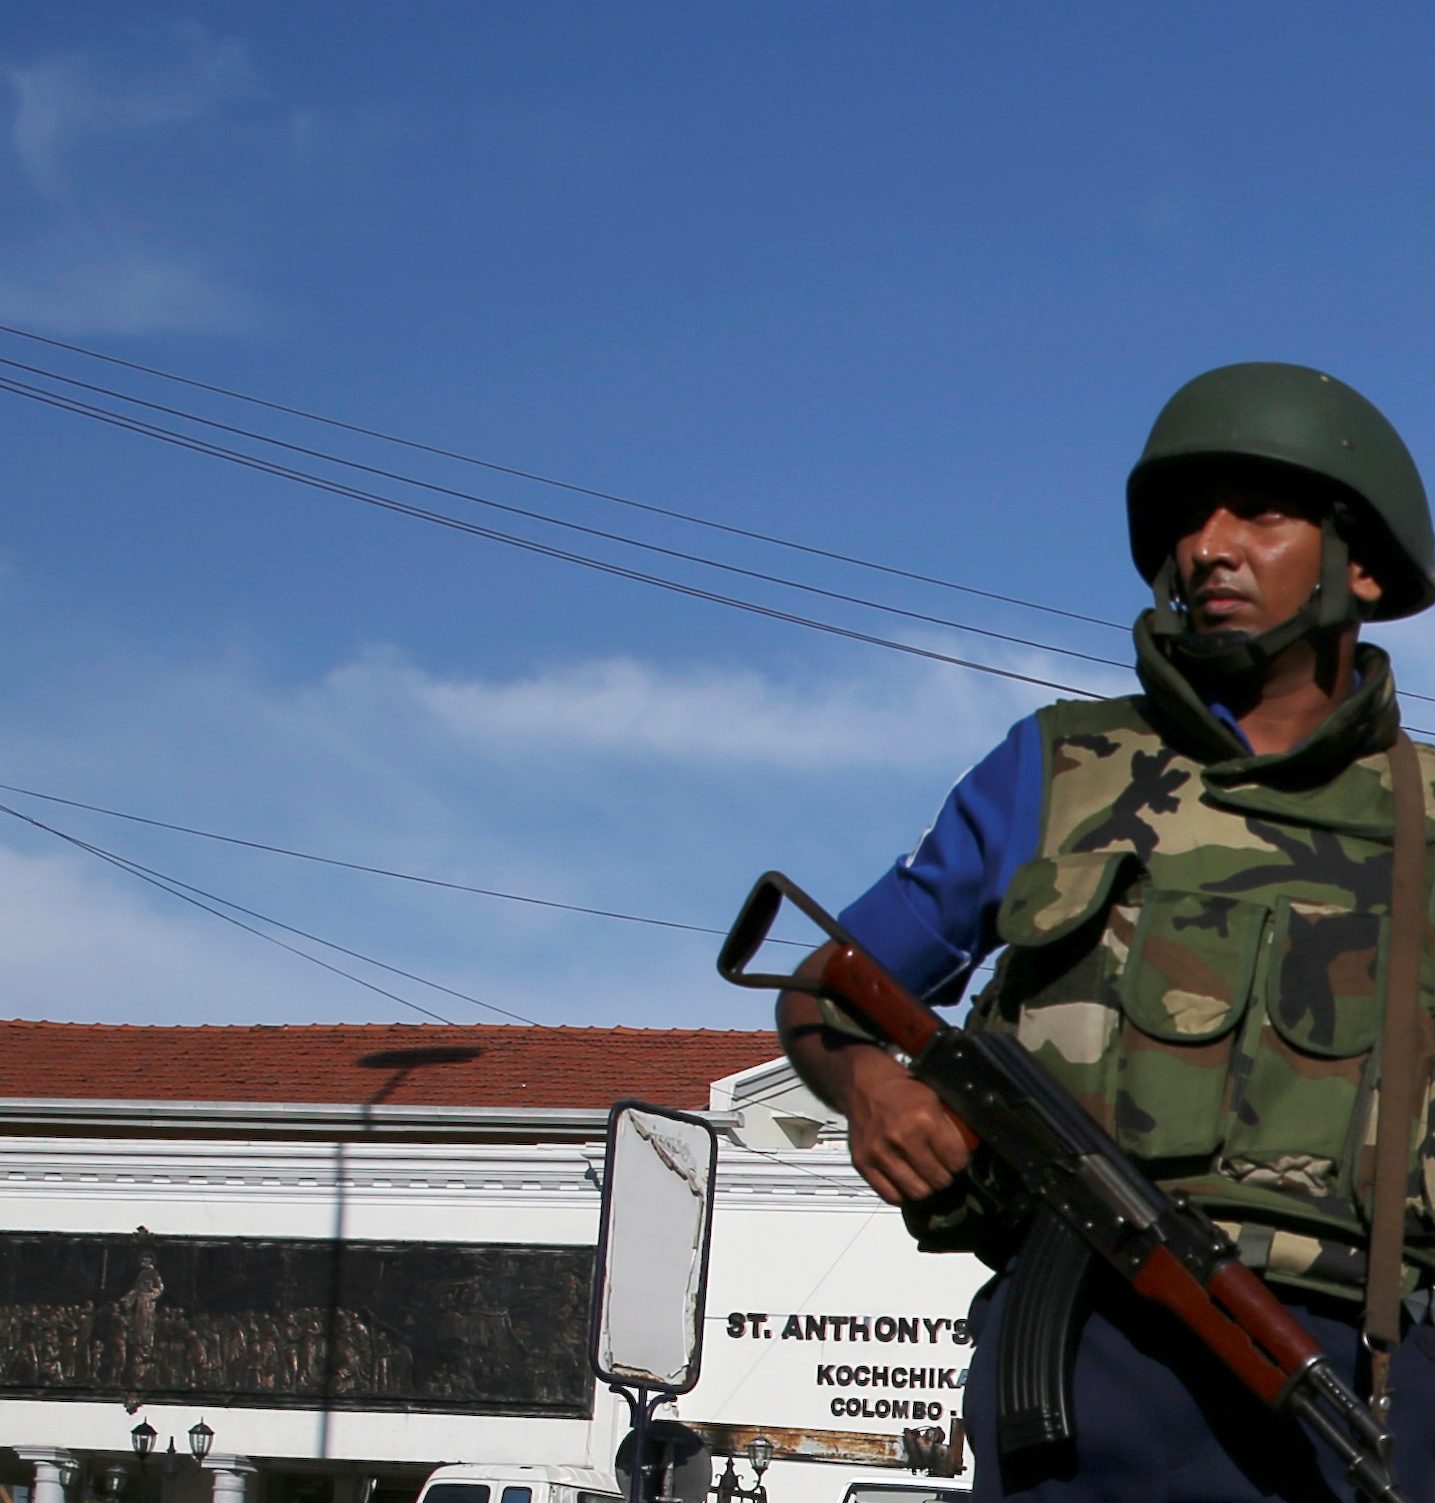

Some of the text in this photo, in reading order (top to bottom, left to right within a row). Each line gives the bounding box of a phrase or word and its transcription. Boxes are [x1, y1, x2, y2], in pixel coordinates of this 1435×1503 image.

[727, 1312, 970, 1345] ST. ANTHONY'S
[830, 1397, 942, 1421] COLOMBO
